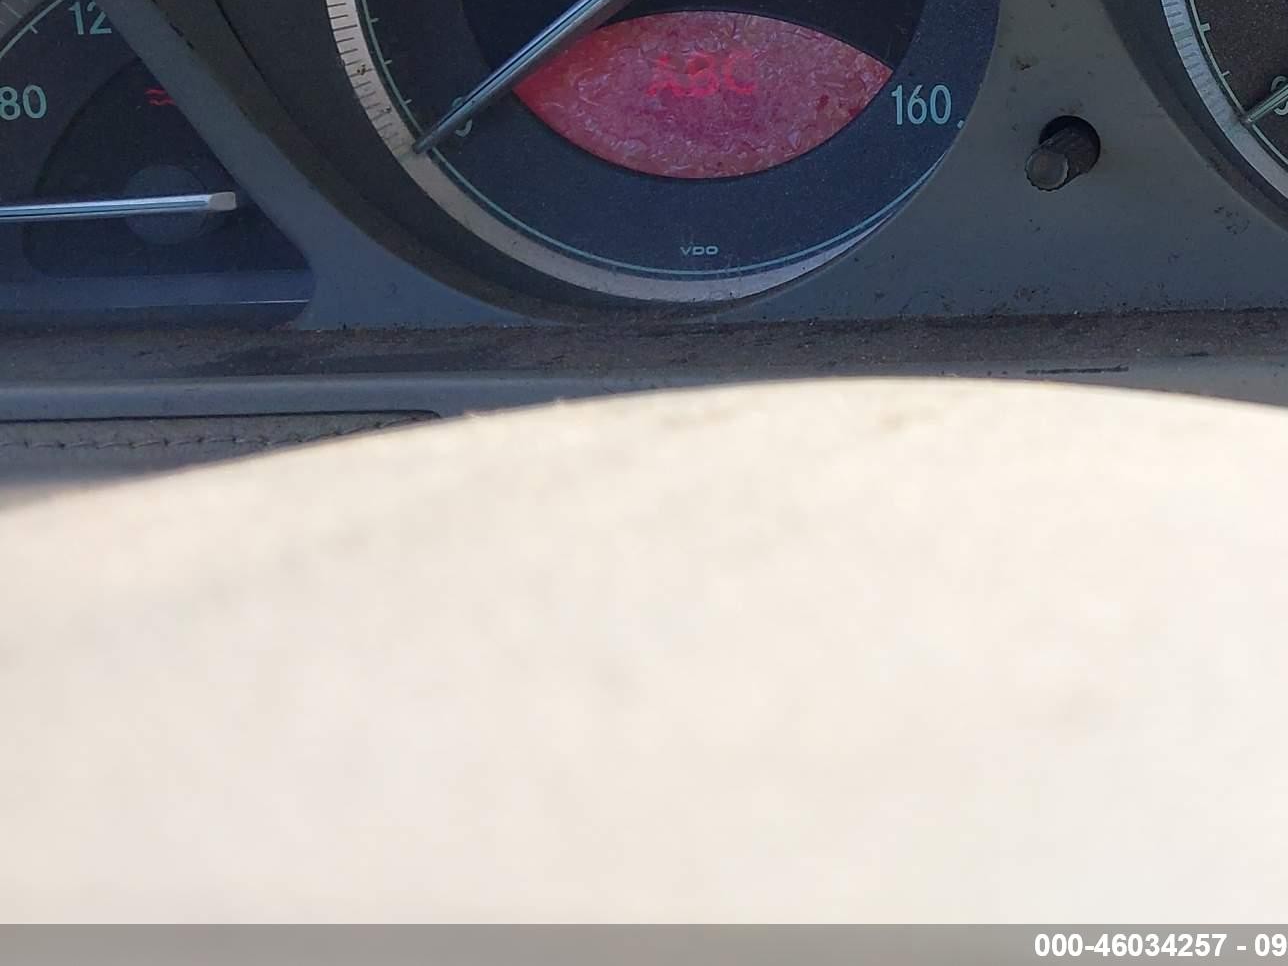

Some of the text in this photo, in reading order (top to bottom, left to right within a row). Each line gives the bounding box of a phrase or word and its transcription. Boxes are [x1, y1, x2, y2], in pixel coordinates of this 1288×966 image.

[0, 83, 47, 122] 80
[891, 84, 953, 126] 160
[679, 245, 719, 256] VDO
